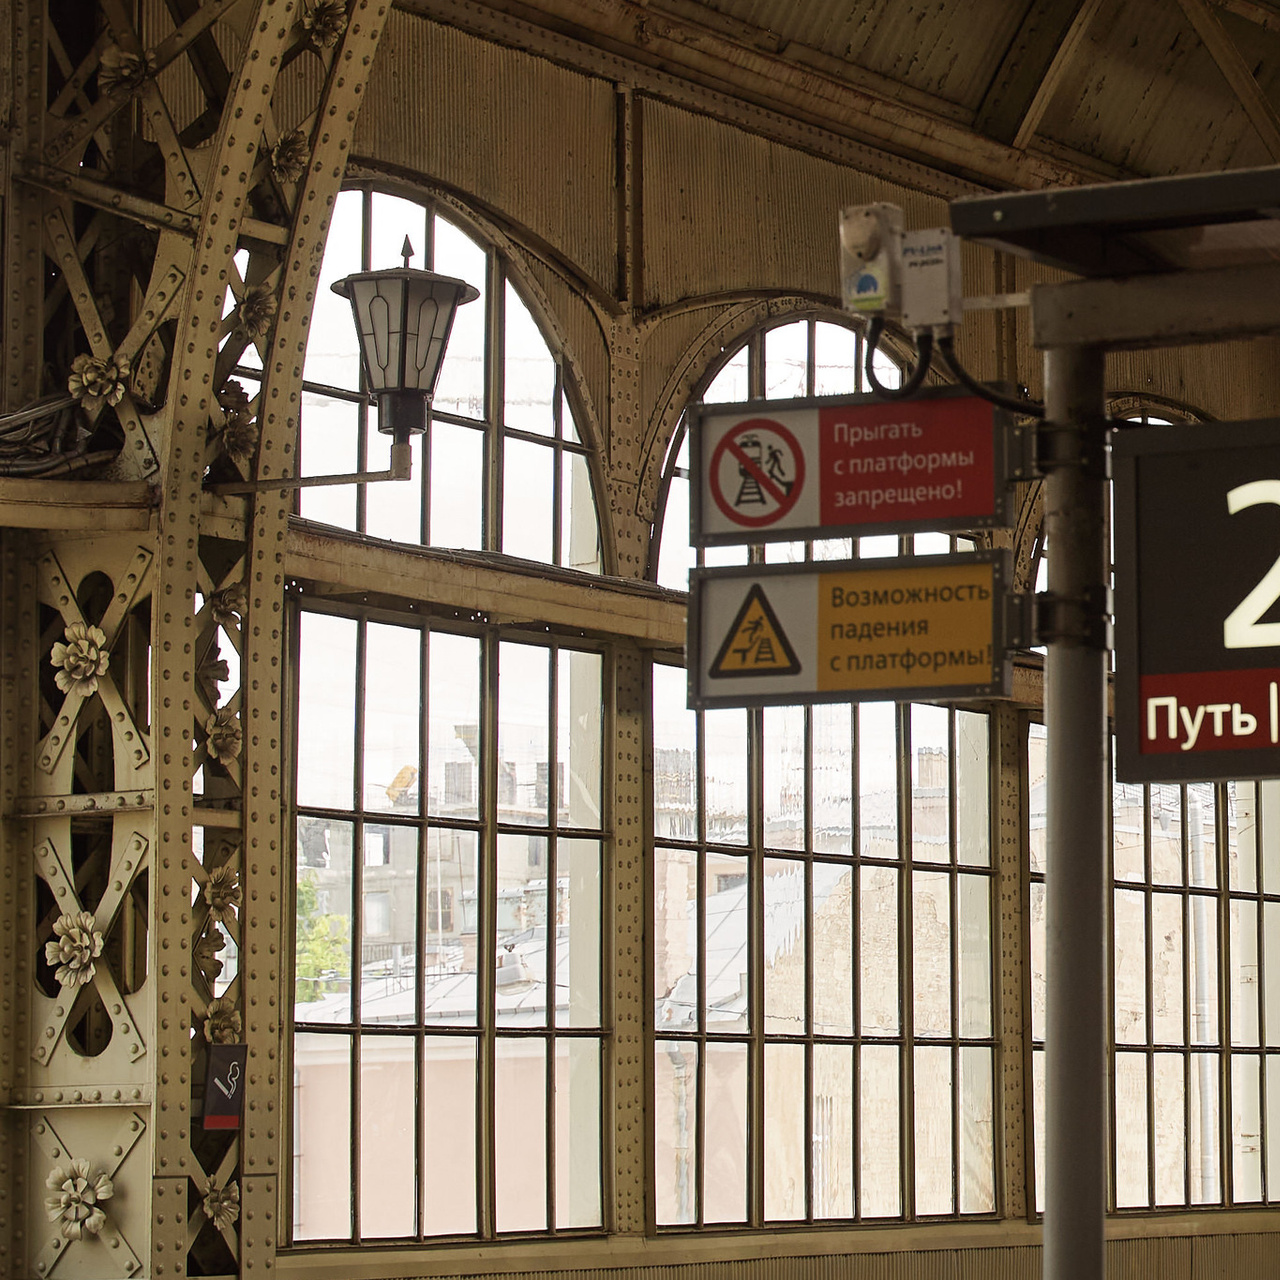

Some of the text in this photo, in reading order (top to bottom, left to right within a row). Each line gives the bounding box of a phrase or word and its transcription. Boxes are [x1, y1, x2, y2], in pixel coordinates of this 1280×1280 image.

[834, 422, 923, 447] Прыгать
[834, 451, 974, 476] с платформы
[834, 479, 962, 510] запрещено!
[831, 584, 991, 609] Возможность
[831, 619, 929, 642] падения
[830, 644, 992, 674] с платформы!
[1147, 695, 1258, 751] Путь
